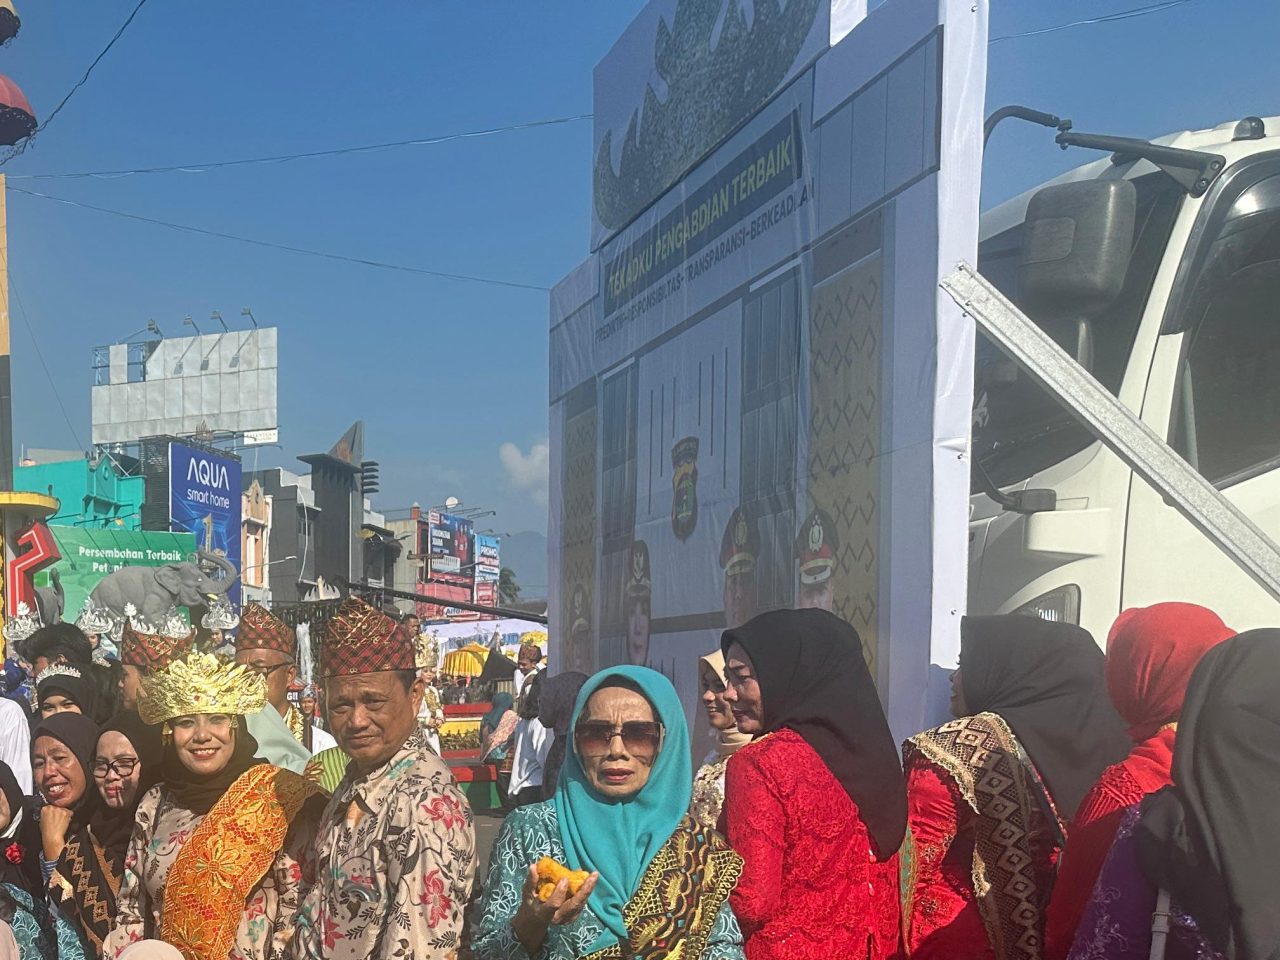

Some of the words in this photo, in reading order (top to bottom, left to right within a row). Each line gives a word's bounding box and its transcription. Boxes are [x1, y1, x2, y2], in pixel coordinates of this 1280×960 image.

[608, 244, 653, 298] TEKADKU
[655, 183, 729, 265] PENGABDIAN
[732, 135, 792, 206] TERBAIK
[187, 457, 230, 491] AQUA
[187, 489, 209, 505] smart
[209, 491, 230, 509] home
[78, 546, 144, 560] Persembahan
[146, 549, 181, 561] Terbaik
